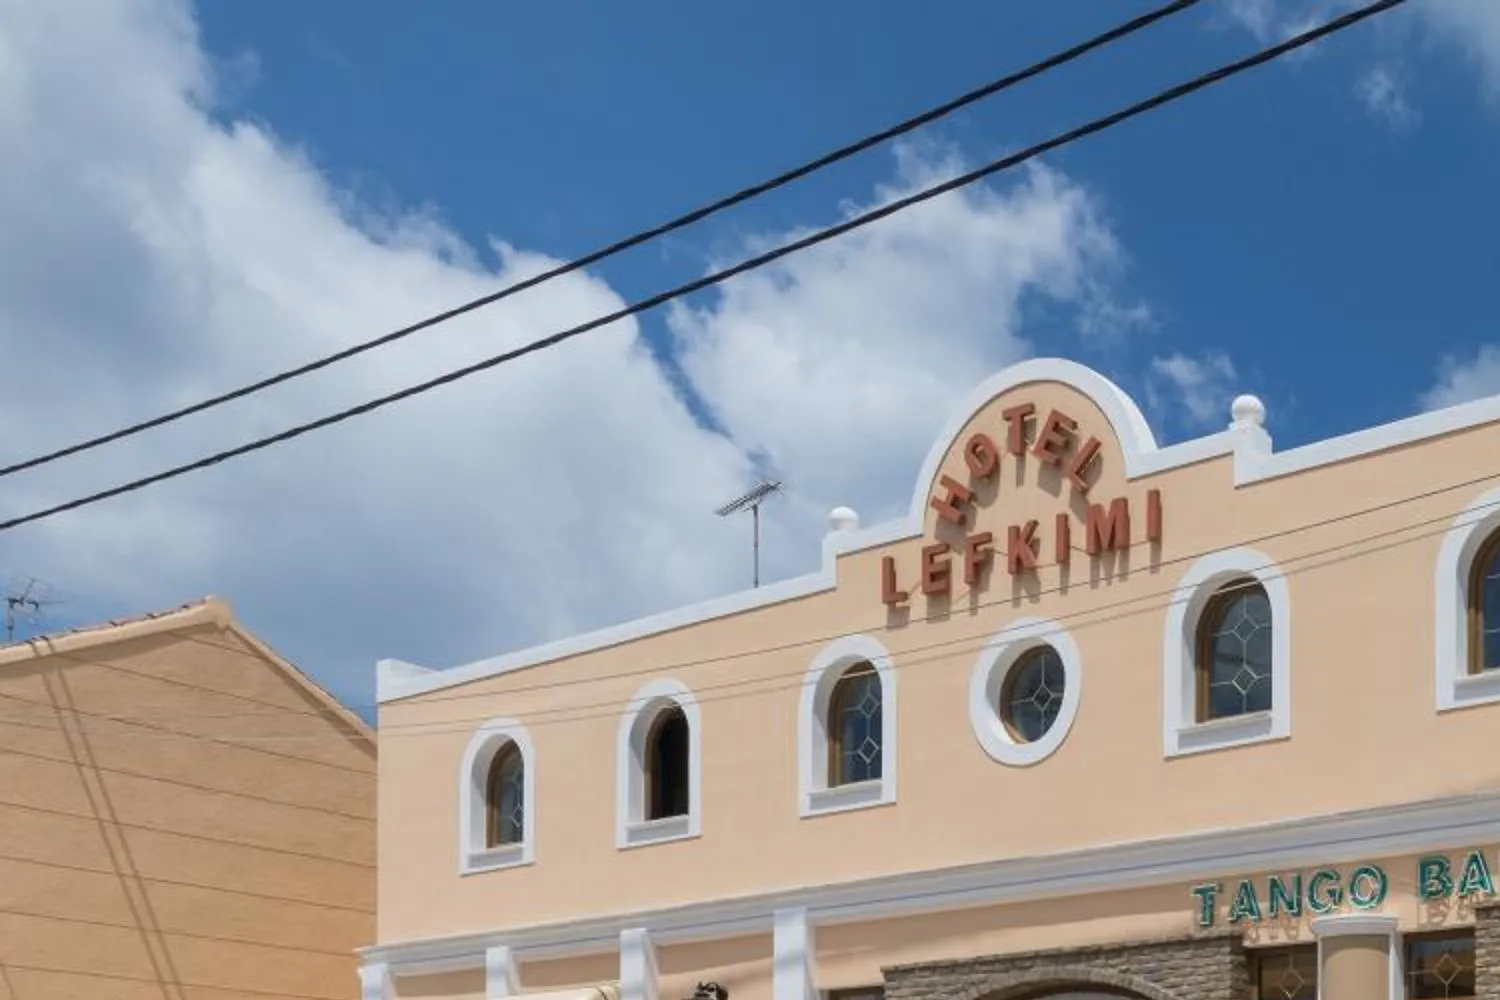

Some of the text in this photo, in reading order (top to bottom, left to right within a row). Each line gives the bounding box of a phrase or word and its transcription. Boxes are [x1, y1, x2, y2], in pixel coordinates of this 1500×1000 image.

[930, 402, 1102, 525] HOTEL
[881, 488, 1163, 606] LEFKIMI
[1191, 864, 1388, 928] TANGO
